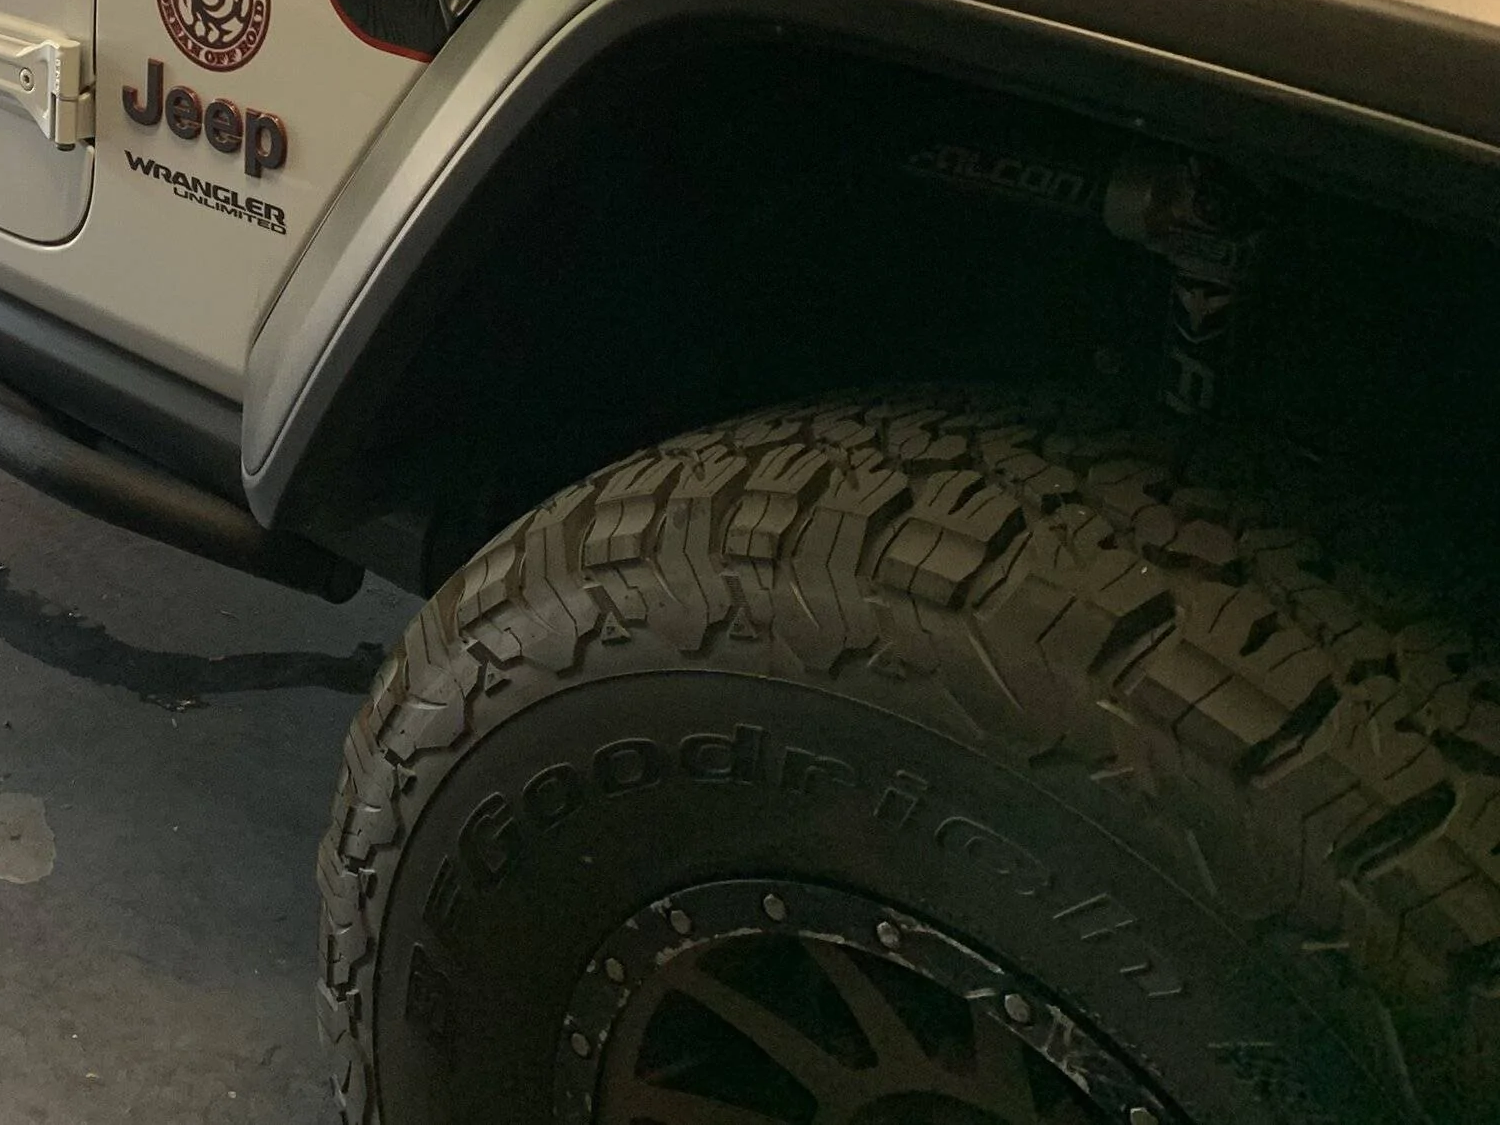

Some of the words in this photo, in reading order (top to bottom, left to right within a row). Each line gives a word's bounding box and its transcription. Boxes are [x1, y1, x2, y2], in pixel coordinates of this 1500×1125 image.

[204, 48, 239, 65] OFF
[238, 0, 266, 57] ROAD
[122, 58, 288, 179] Jeep
[124, 149, 286, 226] WRANGLER
[172, 186, 287, 235] UNLIMITED
